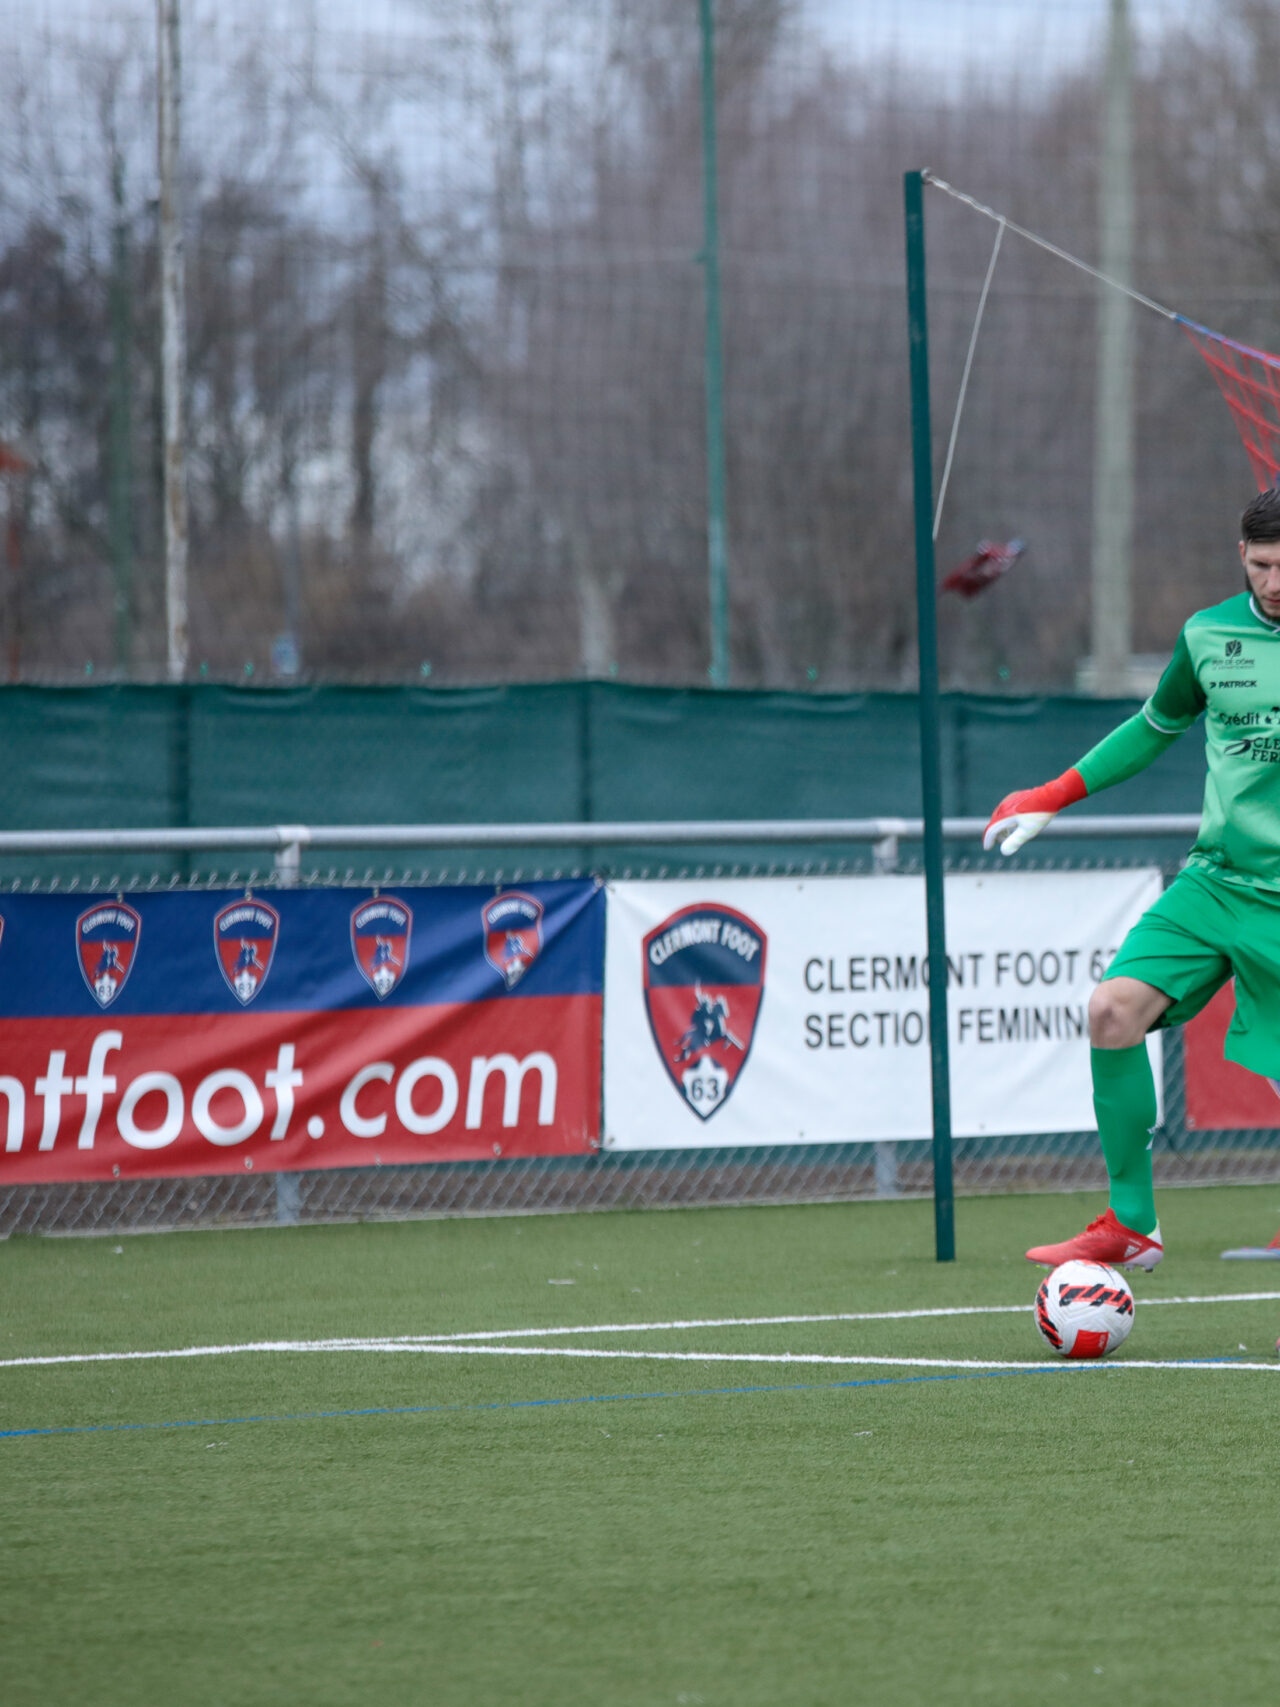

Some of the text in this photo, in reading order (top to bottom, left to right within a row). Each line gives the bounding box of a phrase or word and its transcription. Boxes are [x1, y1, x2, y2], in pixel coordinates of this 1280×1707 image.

[1219, 680, 1257, 689] PATRICK
[1220, 712, 1261, 726] Crédit
[650, 918, 760, 965] CLERMONT FOOT
[995, 950, 1080, 987] FOOT
[804, 1004, 1090, 1049] SECTIO FEMININ
[691, 1078, 719, 1101] 63
